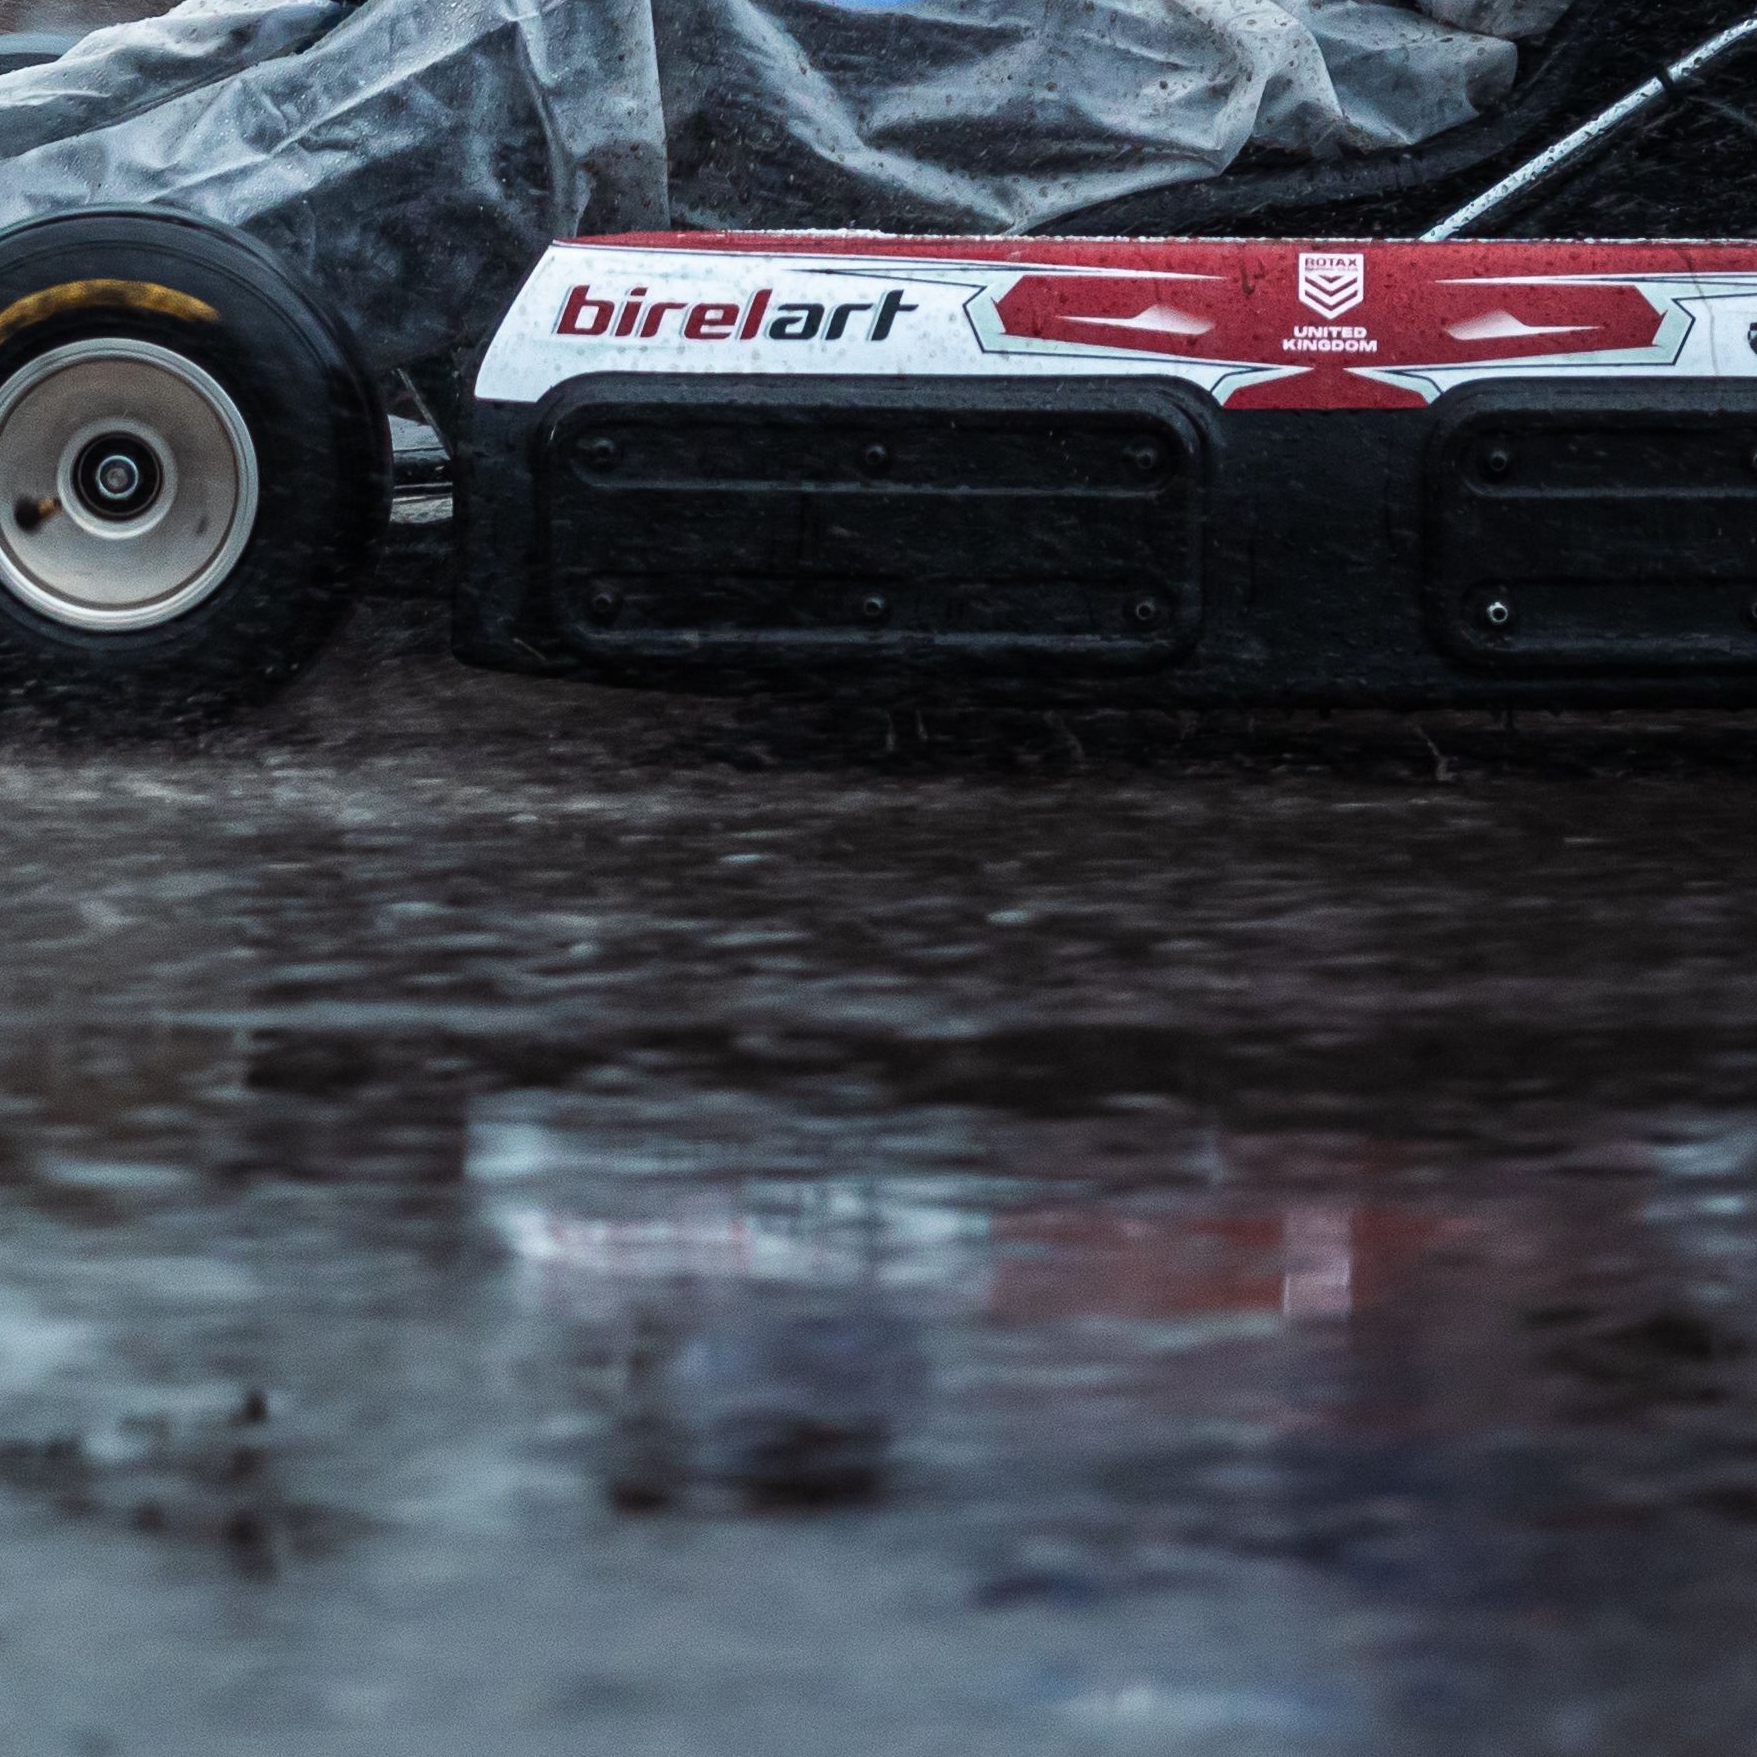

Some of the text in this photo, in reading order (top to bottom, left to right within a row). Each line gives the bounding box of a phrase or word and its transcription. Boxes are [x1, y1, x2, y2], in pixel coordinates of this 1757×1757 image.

[1305, 257, 1357, 268] ROTAX
[552, 284, 919, 341] birelart
[1293, 326, 1368, 338] UNITED
[1281, 338, 1378, 353] KINGDOM
